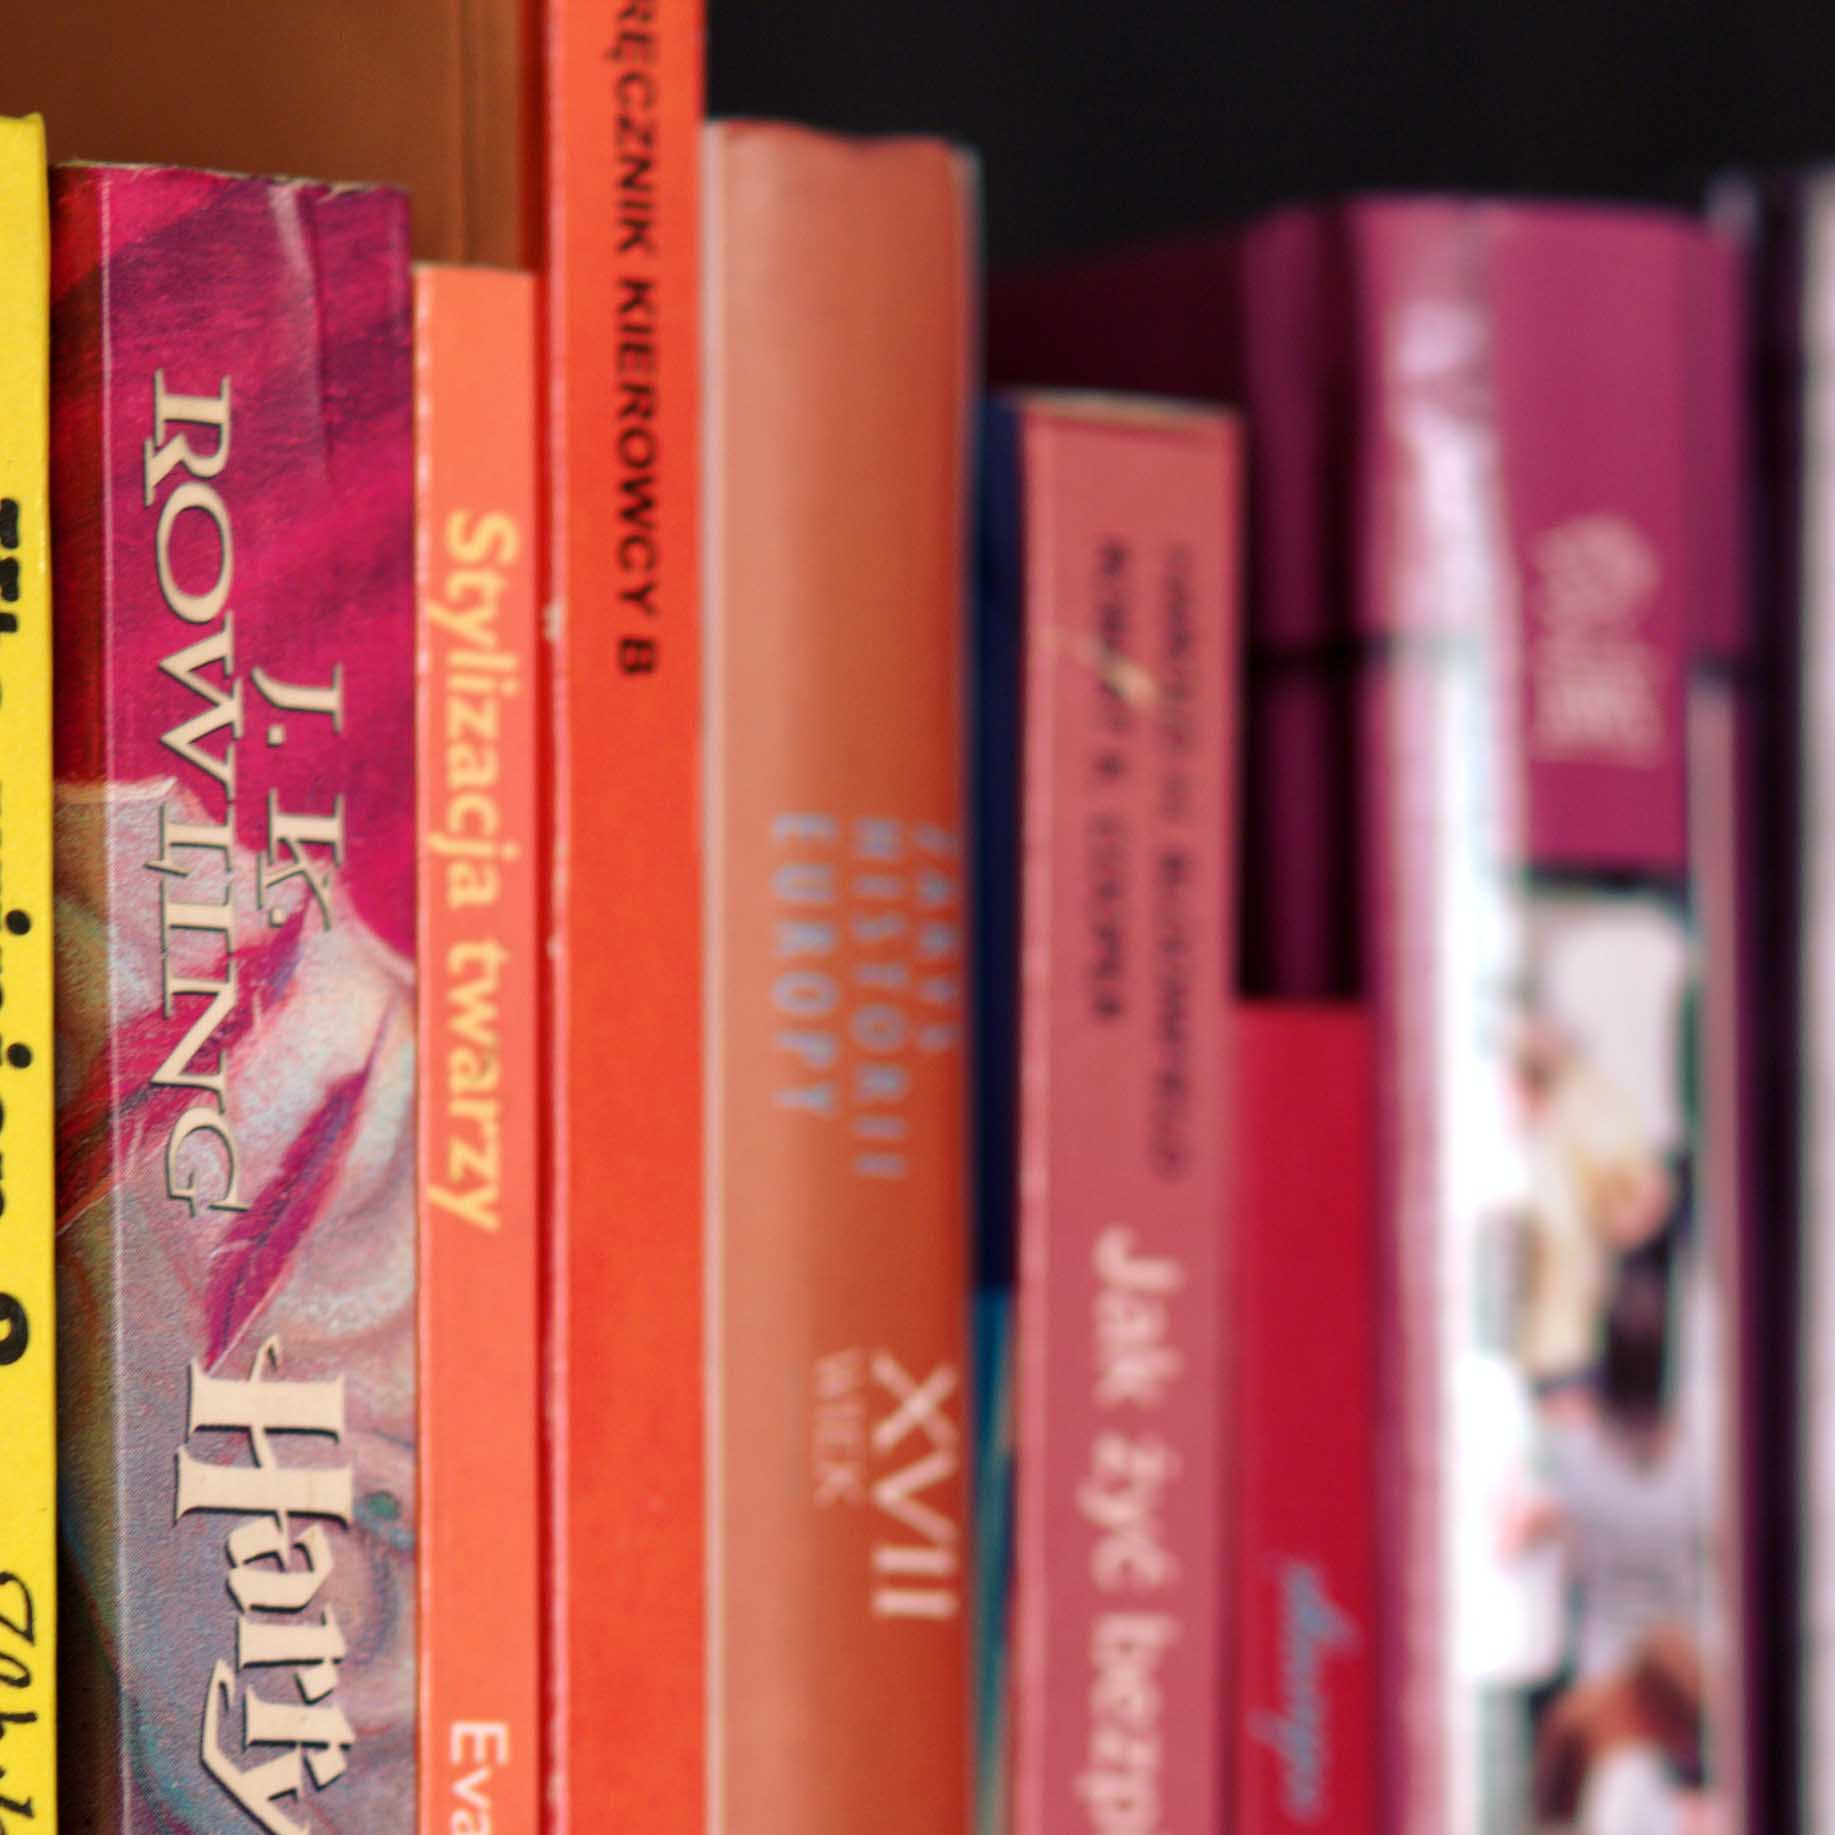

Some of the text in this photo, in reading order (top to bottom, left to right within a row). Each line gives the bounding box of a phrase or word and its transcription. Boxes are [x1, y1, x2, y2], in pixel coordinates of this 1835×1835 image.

[616, 277, 660, 621] KIEROWCY
[616, 637, 660, 676] B
[144, 371, 248, 1219] ROWLING
[252, 664, 346, 933] J. K.
[426, 509, 520, 1232] Stylizacja twarzy
[768, 811, 840, 1120] EUROPY
[848, 816, 910, 1180] HISTORII
[812, 1348, 865, 1506] WIEK
[1095, 1230, 1183, 1405] Jak
[871, 1352, 959, 1619] XVII
[1076, 1434, 1186, 1590] żyć
